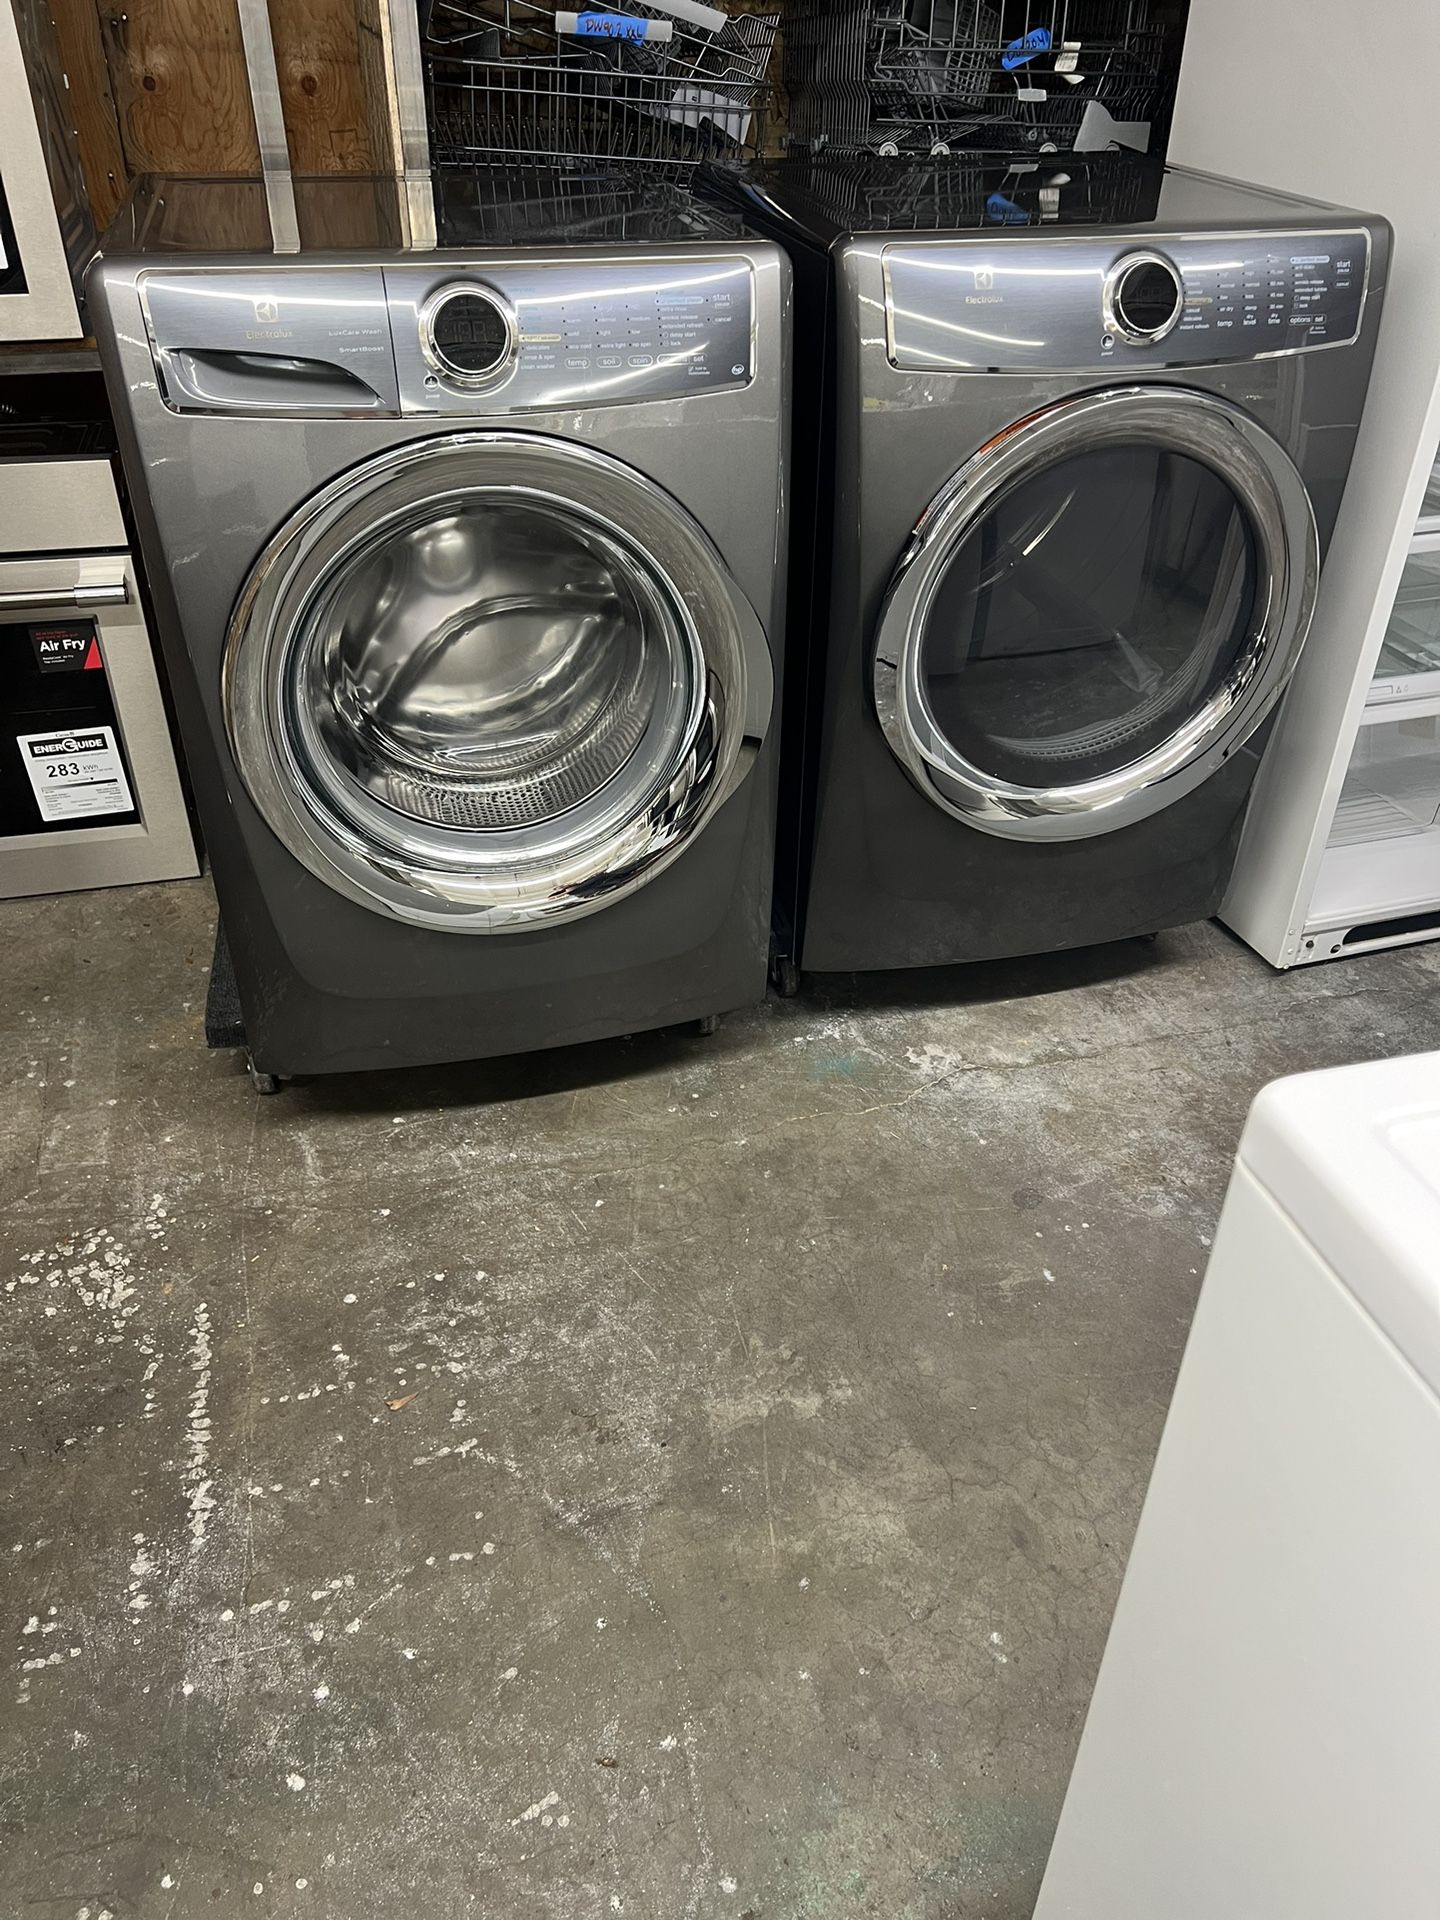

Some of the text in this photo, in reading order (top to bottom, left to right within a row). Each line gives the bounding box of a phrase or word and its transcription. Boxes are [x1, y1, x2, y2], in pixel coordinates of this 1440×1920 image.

[1336, 260, 1351, 268] start
[965, 295, 1003, 304] Electrolux
[246, 329, 292, 339] Electrolux
[567, 359, 587, 368] temp
[632, 357, 648, 366] spin
[40, 639, 85, 652] Air Fry
[46, 763, 80, 778] 283
